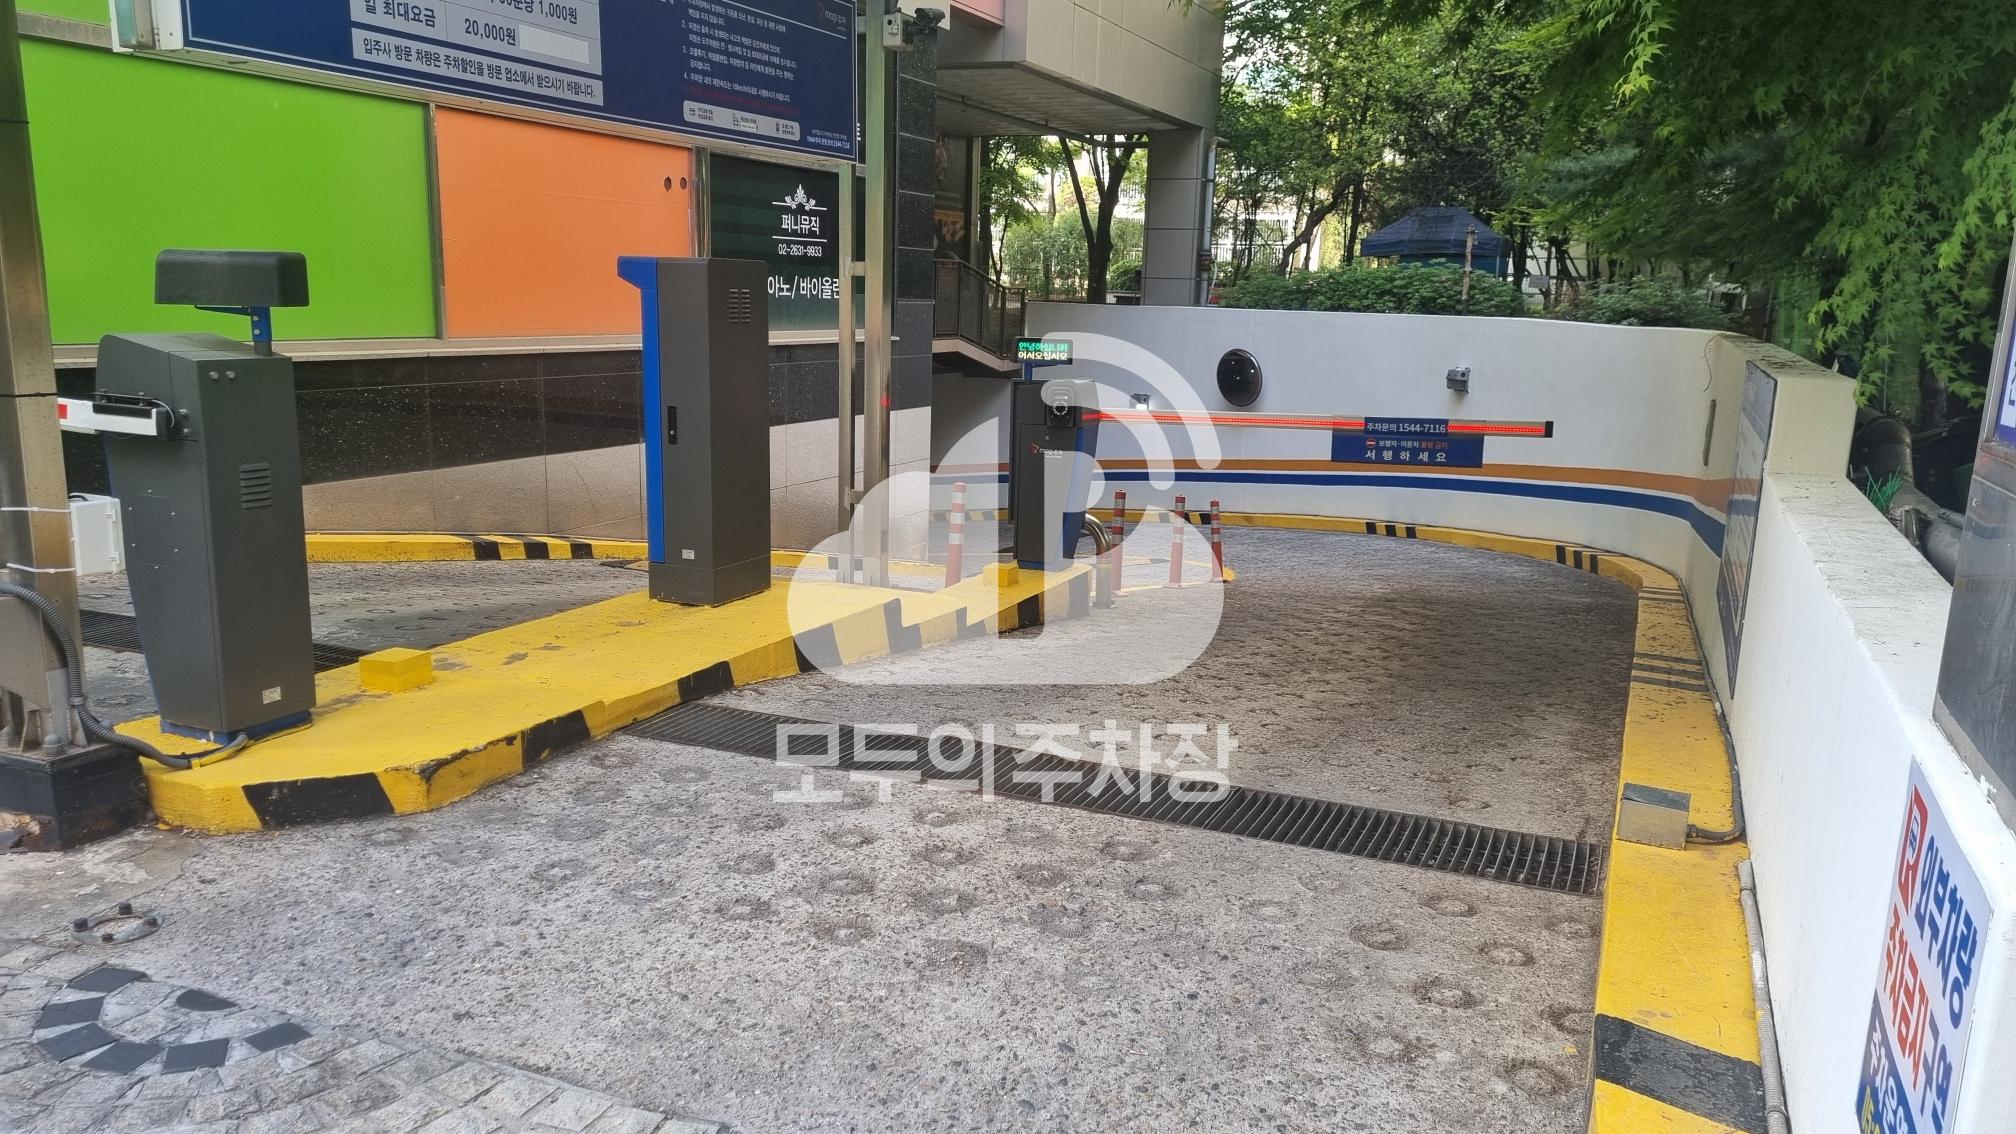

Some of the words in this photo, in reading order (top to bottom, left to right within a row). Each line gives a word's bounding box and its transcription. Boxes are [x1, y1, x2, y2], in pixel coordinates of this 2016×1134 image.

[383, 0, 436, 28] 최대요금
[539, 1, 578, 24] 1,000원
[464, 18, 516, 46] 20,000원
[363, 38, 392, 58] 입주사
[394, 44, 412, 62] 방문
[415, 48, 442, 68] 차량은
[443, 54, 485, 77] 주차할인을
[486, 63, 502, 80] 방문
[505, 67, 535, 87] 업소에서
[536, 74, 565, 93] 받으시기
[781, 213, 820, 235] 퍼니뮤직
[778, 243, 822, 257] 02-2631-9933
[1018, 351, 1068, 360] 어서오십시오
[1366, 423, 1397, 432] 주차문의
[1398, 423, 1446, 433] 1544-7116
[1914, 835, 1978, 1029] 외부차량
